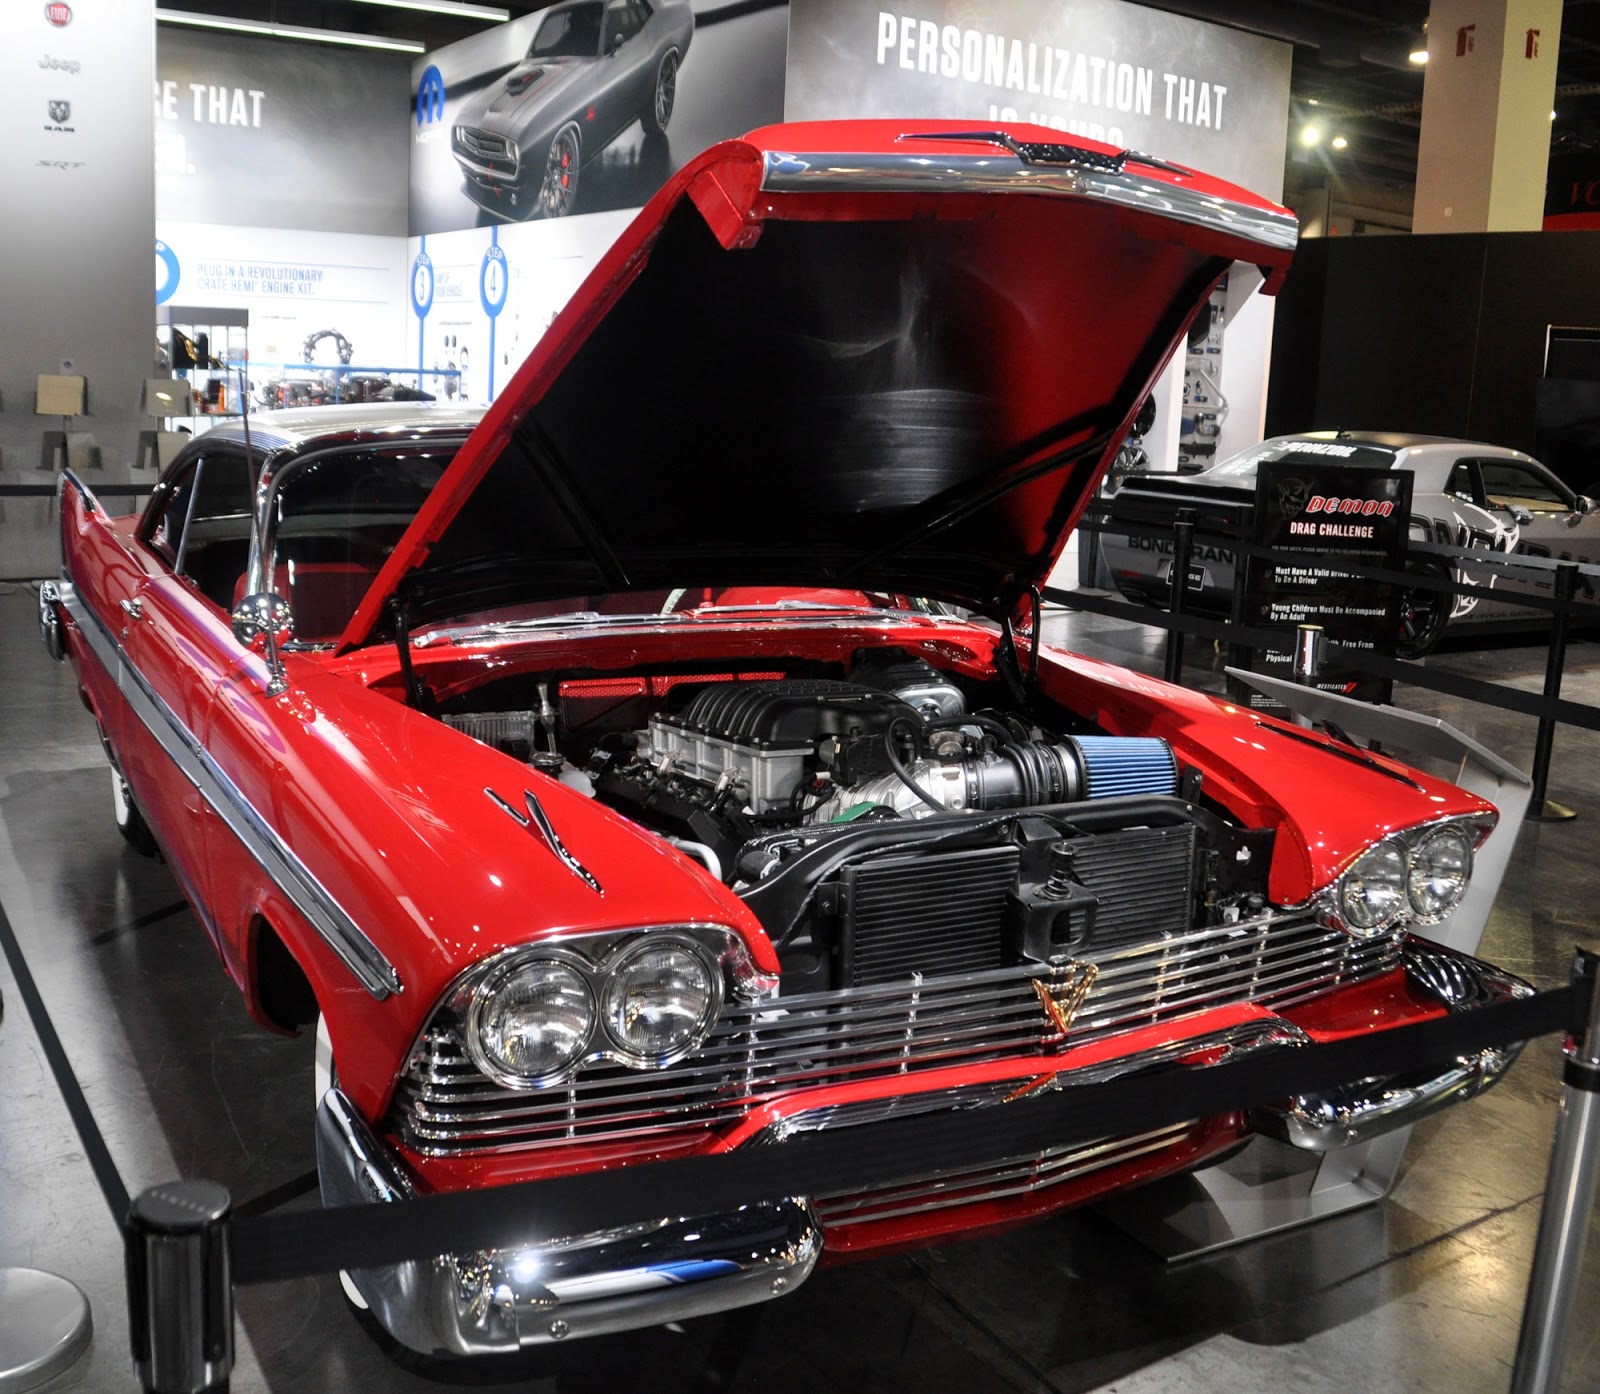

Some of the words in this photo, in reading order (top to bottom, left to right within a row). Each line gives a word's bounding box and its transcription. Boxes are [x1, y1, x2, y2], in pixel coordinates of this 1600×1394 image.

[50, 6, 68, 22] FIAT
[37, 54, 81, 75] Jeep
[876, 11, 1154, 116] PERSONALIZATION
[1163, 73, 1227, 131] THAT
[189, 83, 266, 128] THAT
[35, 160, 87, 170] SRT
[416, 253, 430, 266] STEP
[487, 246, 503, 260] STEP
[198, 264, 222, 277] PLUG
[226, 265, 235, 277] IN
[238, 266, 244, 278] A
[248, 266, 323, 282] REVOLUTIONARY
[490, 265, 497, 297] 4
[198, 278, 227, 291] CRATE
[262, 281, 294, 294] ENGINE
[298, 282, 315, 296] KIT.
[420, 271, 424, 300] 3
[1306, 495, 1394, 517] DEMON
[1290, 522, 1316, 536] DRAG
[1319, 523, 1374, 539] CHALLENGE
[1275, 566, 1291, 575] Must
[1292, 567, 1307, 576] Have
[1308, 568, 1313, 576] A
[1314, 568, 1329, 577] Valid
[1275, 575, 1281, 583] To
[1293, 576, 1298, 584] A
[1298, 576, 1318, 585] Driver
[1270, 612, 1278, 621] By
[1289, 612, 1305, 621] Adult
[1271, 603, 1290, 613] Young
[1292, 604, 1318, 613] Children
[1319, 606, 1334, 614] Must
[1335, 606, 1343, 614] Be
[1344, 607, 1386, 616] Accompanied
[1342, 640, 1357, 648] Free
[1358, 641, 1374, 649] From
[1265, 654, 1292, 663] Physical
